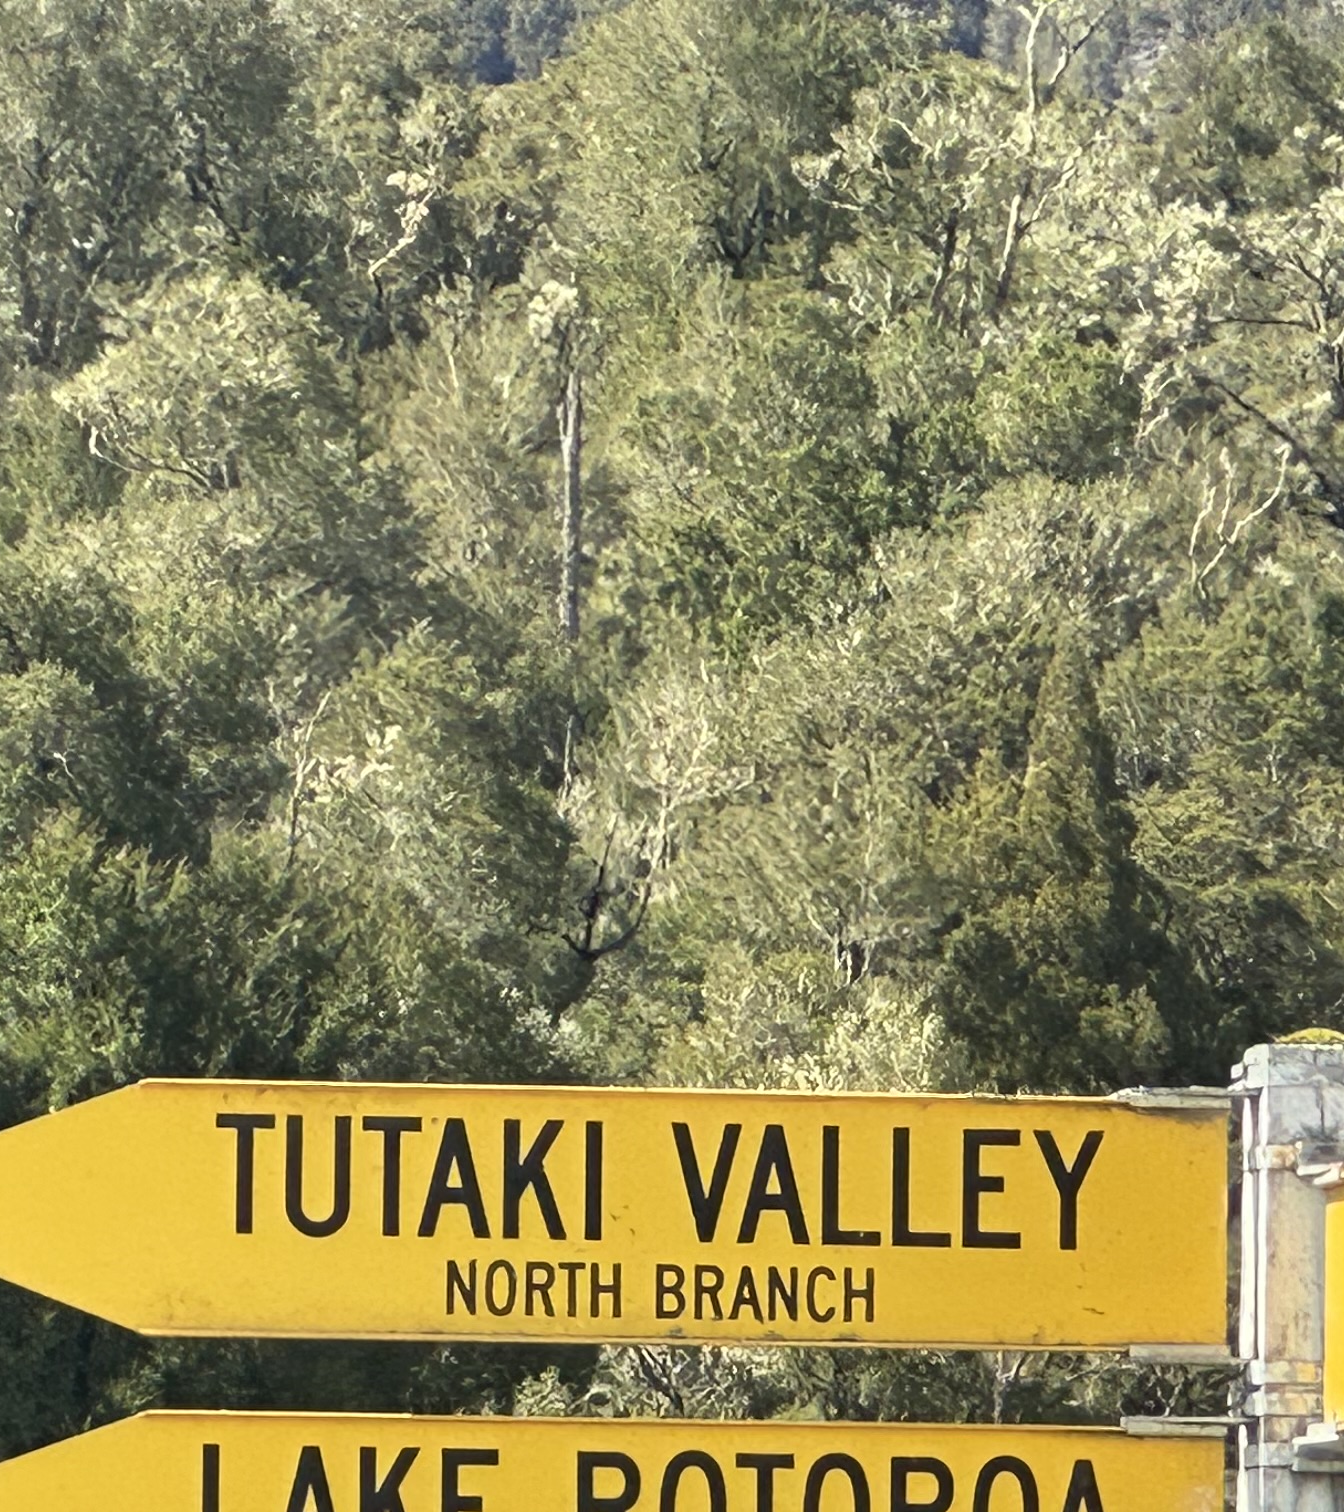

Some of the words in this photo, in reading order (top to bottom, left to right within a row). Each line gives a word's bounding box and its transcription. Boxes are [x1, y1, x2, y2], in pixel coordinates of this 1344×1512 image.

[216, 1112, 604, 1241] TUTAKI
[671, 1121, 1105, 1251] VALLEY
[446, 1258, 622, 1318] NORTH
[655, 1263, 875, 1325] BRANCH
